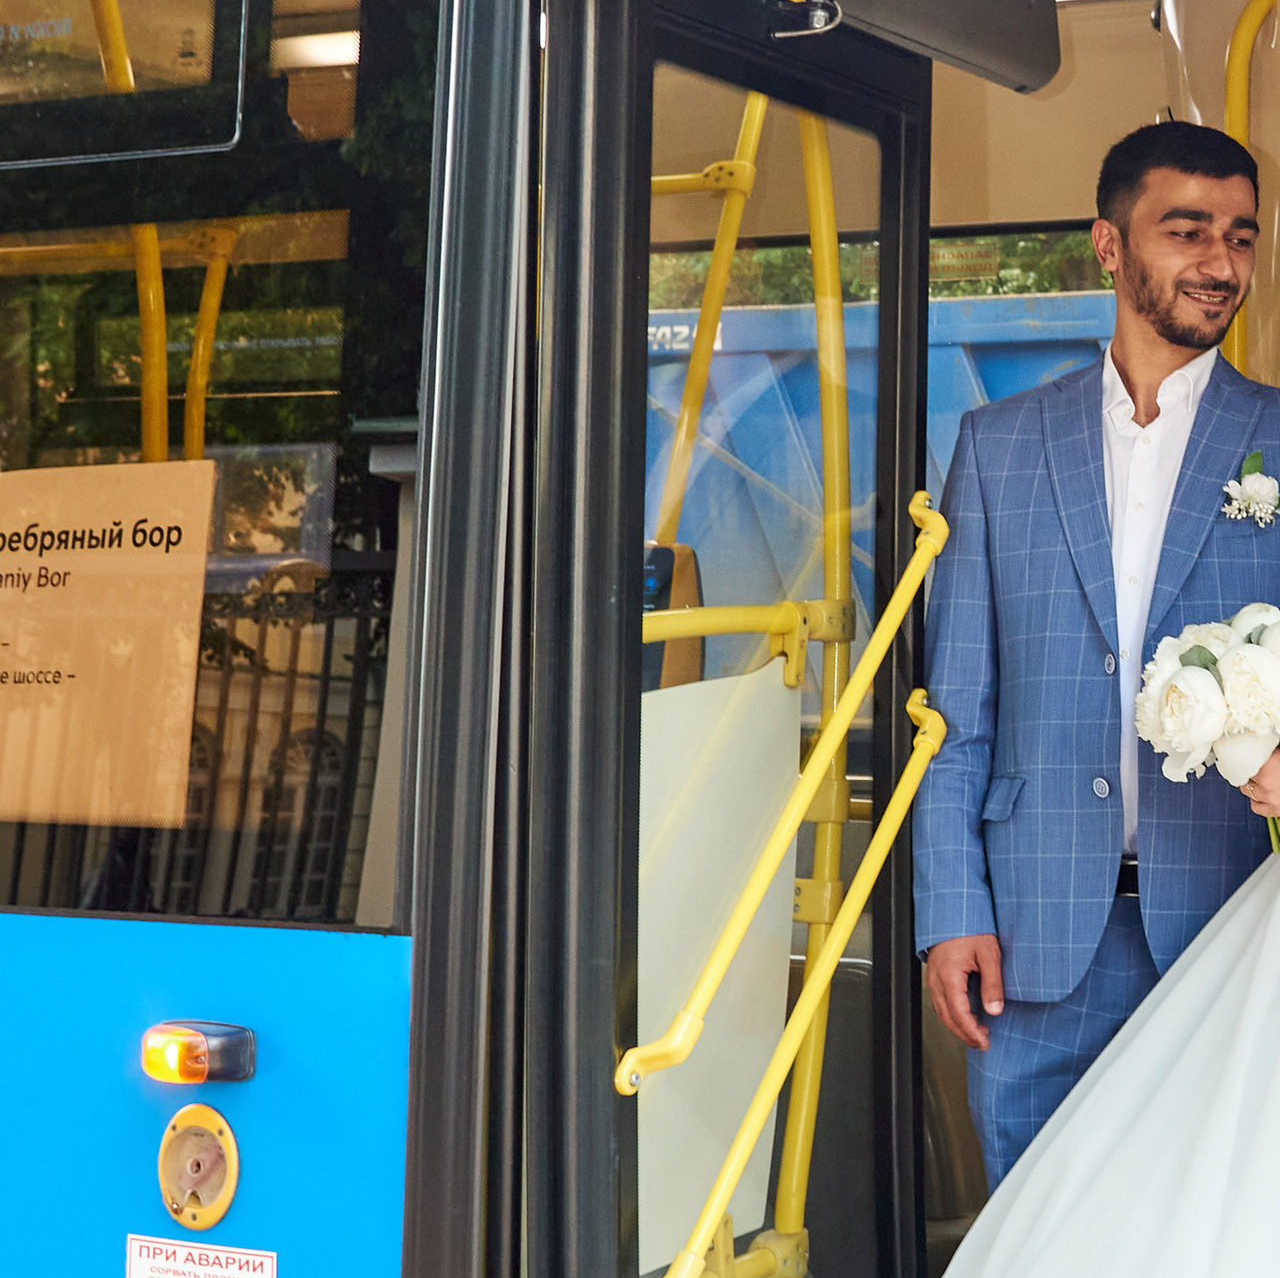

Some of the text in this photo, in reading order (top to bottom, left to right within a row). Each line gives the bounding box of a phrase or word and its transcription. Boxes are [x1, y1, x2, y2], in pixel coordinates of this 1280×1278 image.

[132, 518, 183, 554] бор
[37, 565, 71, 588] Bor
[13, 670, 61, 685] шоссе
[139, 1245, 264, 1273] ПРИ АВАРИИ
[149, 1266, 200, 1278] СОРВАТЬ
